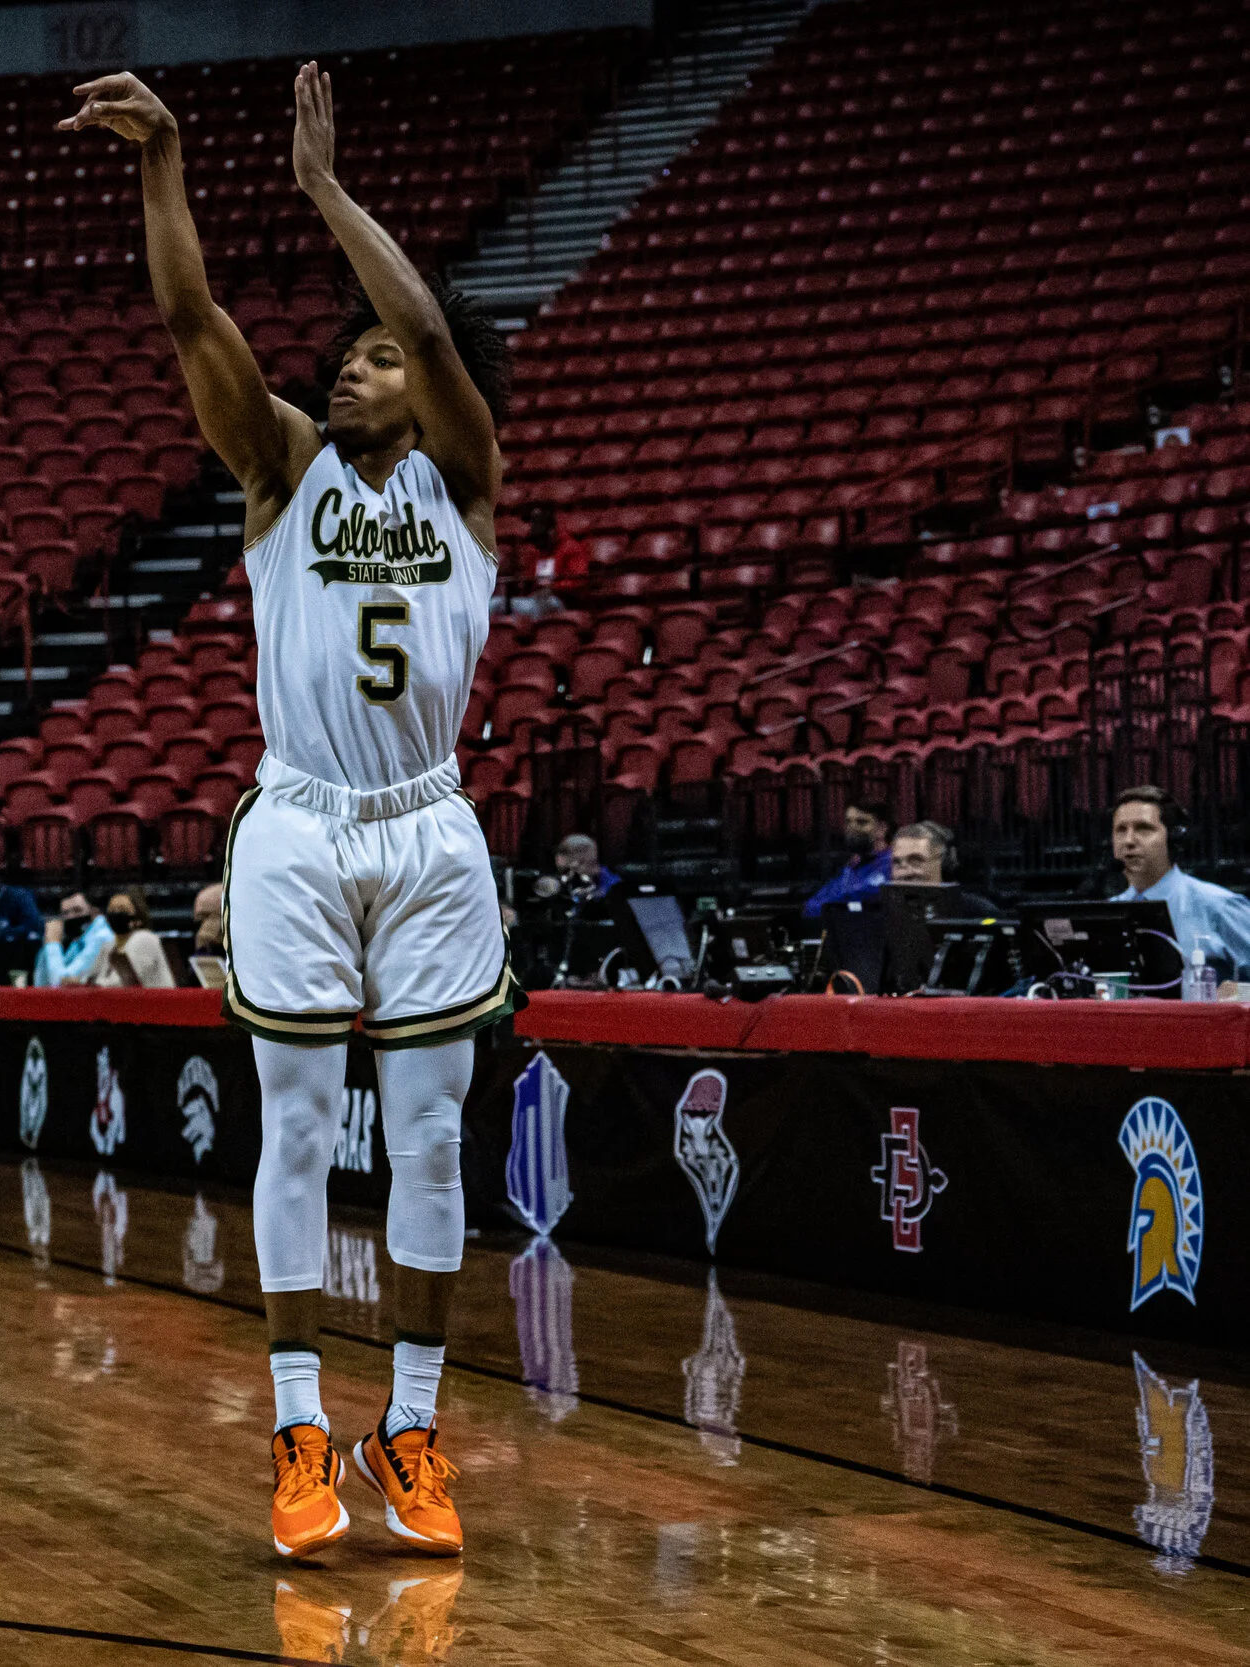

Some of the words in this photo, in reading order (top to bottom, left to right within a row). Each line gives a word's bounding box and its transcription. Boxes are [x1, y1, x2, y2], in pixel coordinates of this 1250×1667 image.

[311, 487, 444, 563] Coloado
[348, 563, 387, 582] STATE
[390, 565, 421, 584] UNIV
[356, 602, 410, 706] 5
